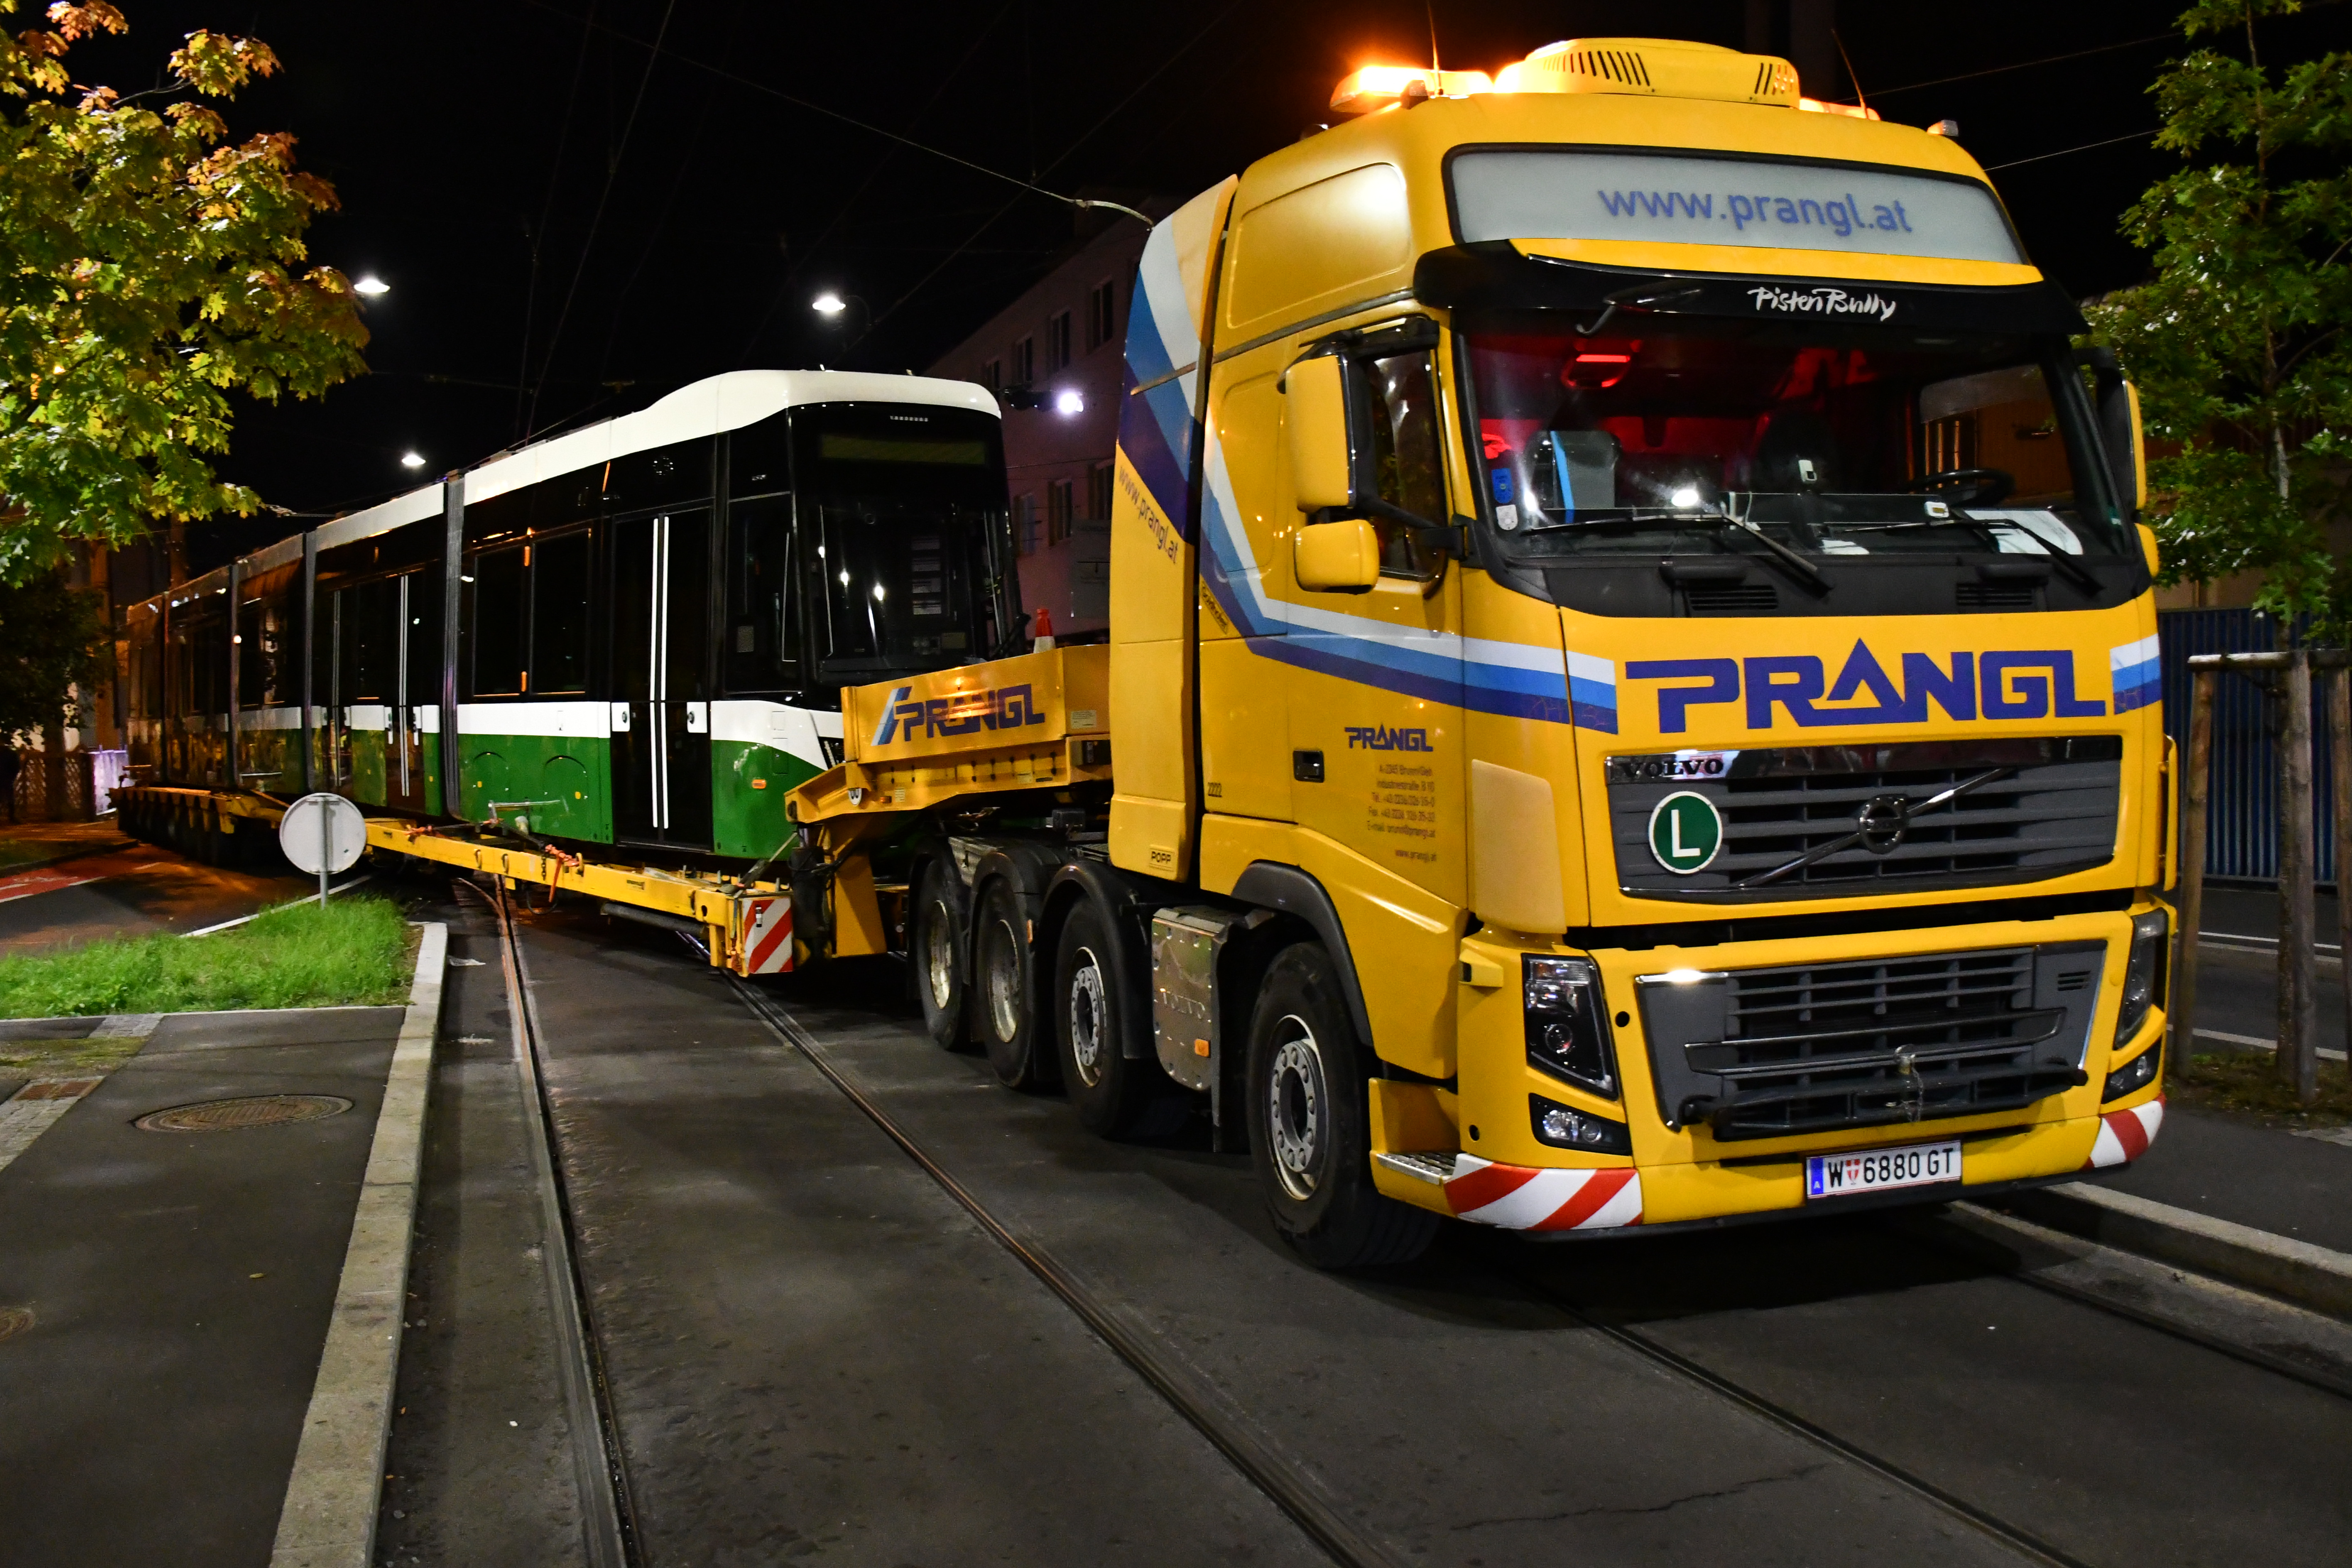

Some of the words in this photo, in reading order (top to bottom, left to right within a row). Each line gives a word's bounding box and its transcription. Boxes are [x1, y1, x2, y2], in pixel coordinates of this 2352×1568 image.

[1598, 190, 1912, 237] www.prangl.at
[1747, 286, 1896, 322] PistenBully
[1119, 466, 1178, 565] www.prangl.at
[1626, 638, 2106, 733] PRANGL
[895, 683, 1045, 742] PRANGL
[1345, 722, 1433, 752] PRANGL
[1620, 759, 1723, 778] VOLVO
[1671, 809, 1701, 858] L
[1813, 1181, 1821, 1189] A
[1828, 1160, 1843, 1188] W
[1863, 1152, 1920, 1183] 6880
[1927, 1148, 1954, 1176] GT
